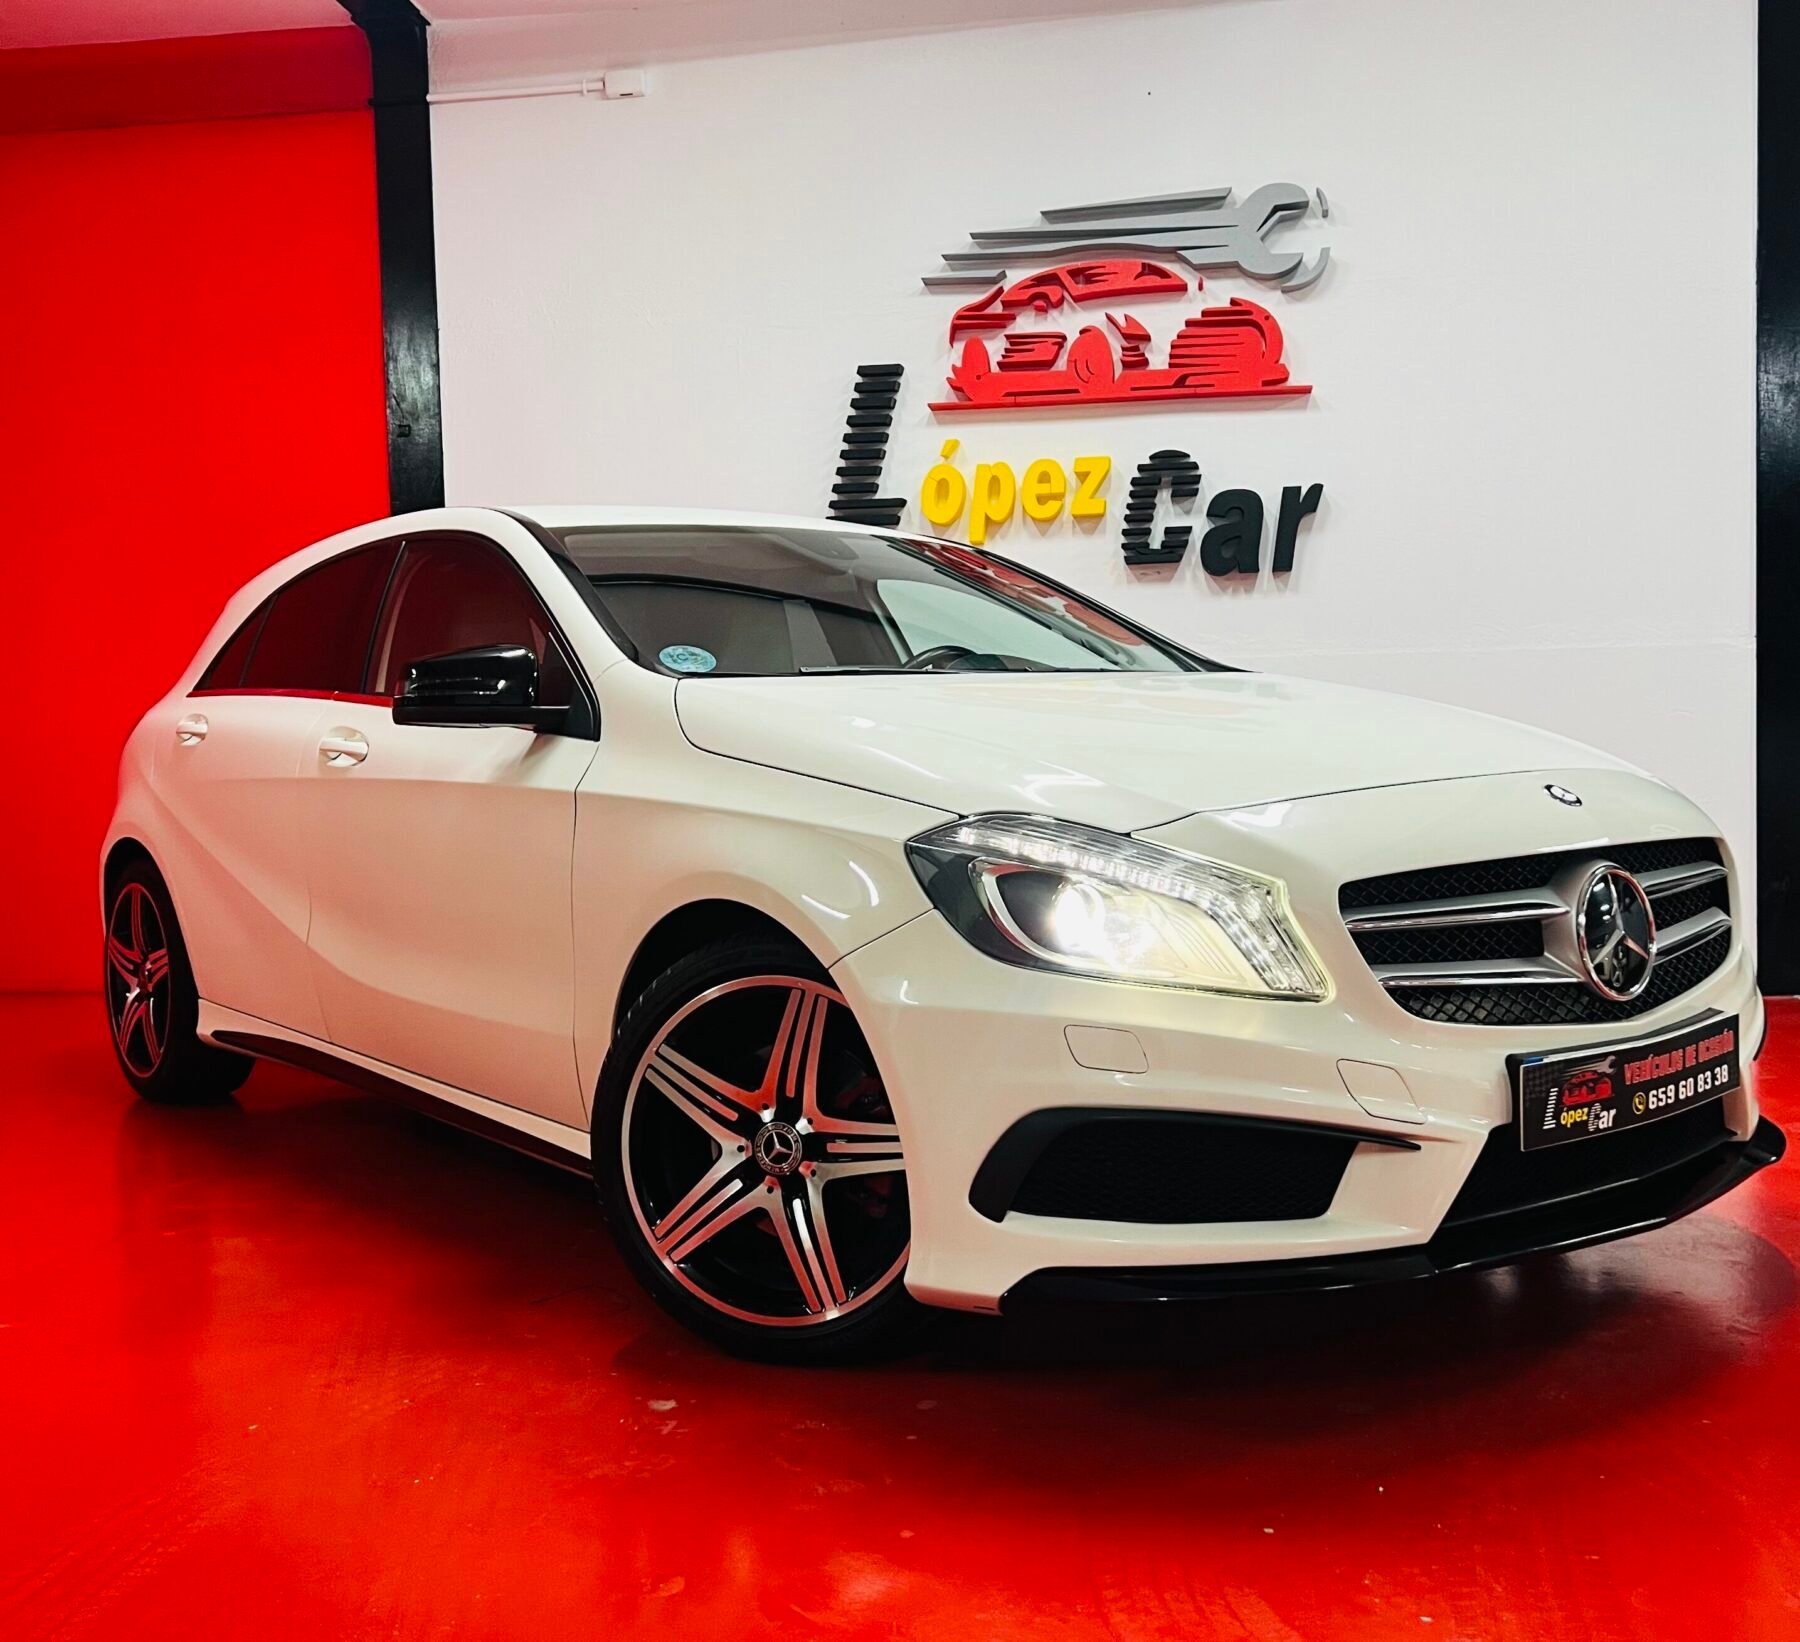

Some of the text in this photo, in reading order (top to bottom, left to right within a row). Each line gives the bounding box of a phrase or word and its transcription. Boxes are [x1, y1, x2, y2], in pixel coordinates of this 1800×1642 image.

[826, 363, 1324, 577] López Car
[1624, 1053, 1684, 1086] VEHÍCULOS
[1685, 1044, 1697, 1068] DE
[1648, 1064, 1729, 1110] 659 60 83 38
[1588, 1102, 1617, 1132] Car
